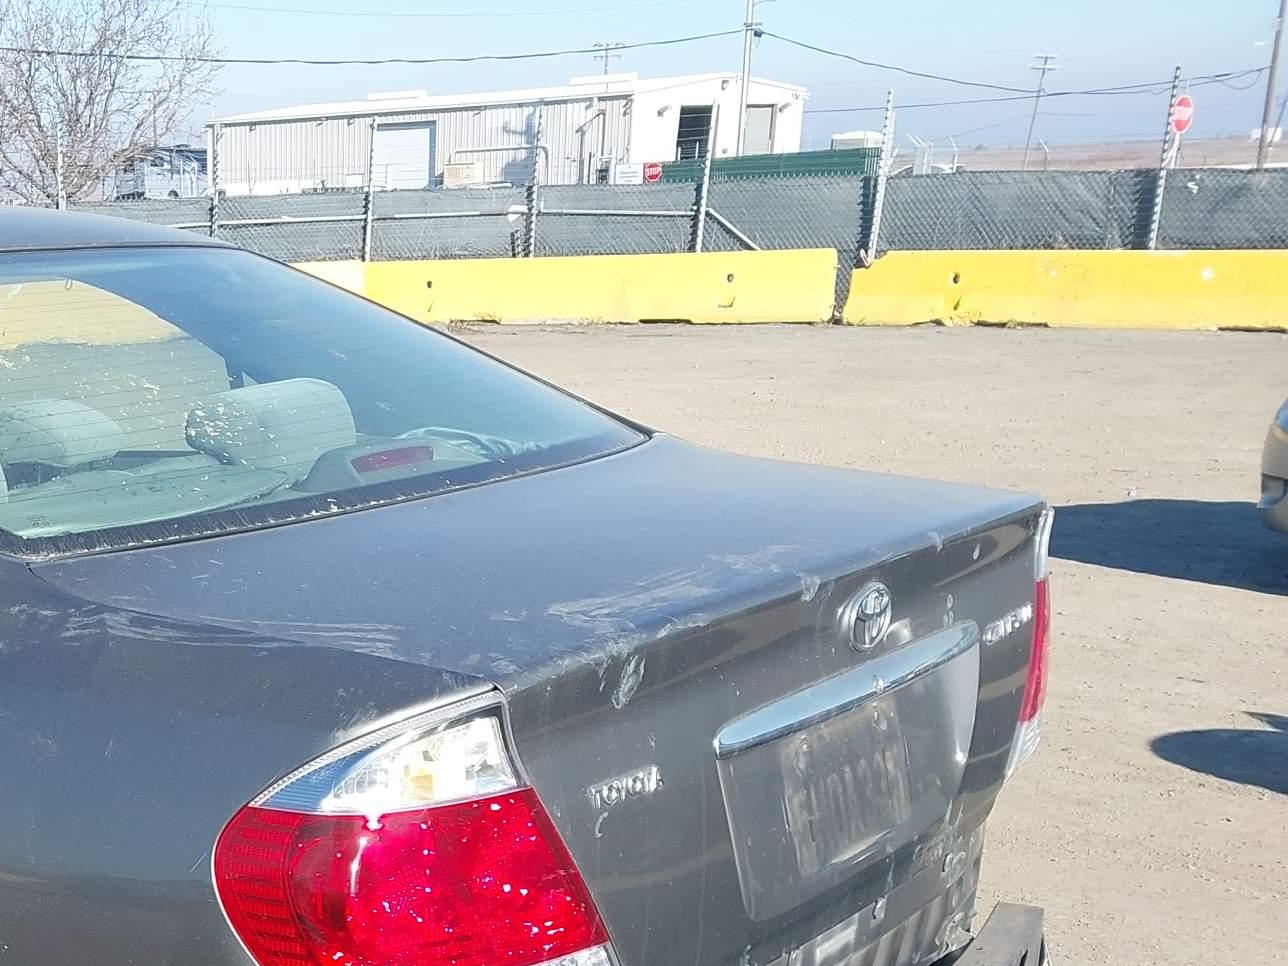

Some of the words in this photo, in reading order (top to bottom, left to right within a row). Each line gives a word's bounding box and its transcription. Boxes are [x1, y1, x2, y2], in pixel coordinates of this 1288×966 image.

[1172, 106, 1192, 121] STOP
[645, 166, 661, 176] STOP
[587, 765, 664, 809] TOYOTA
